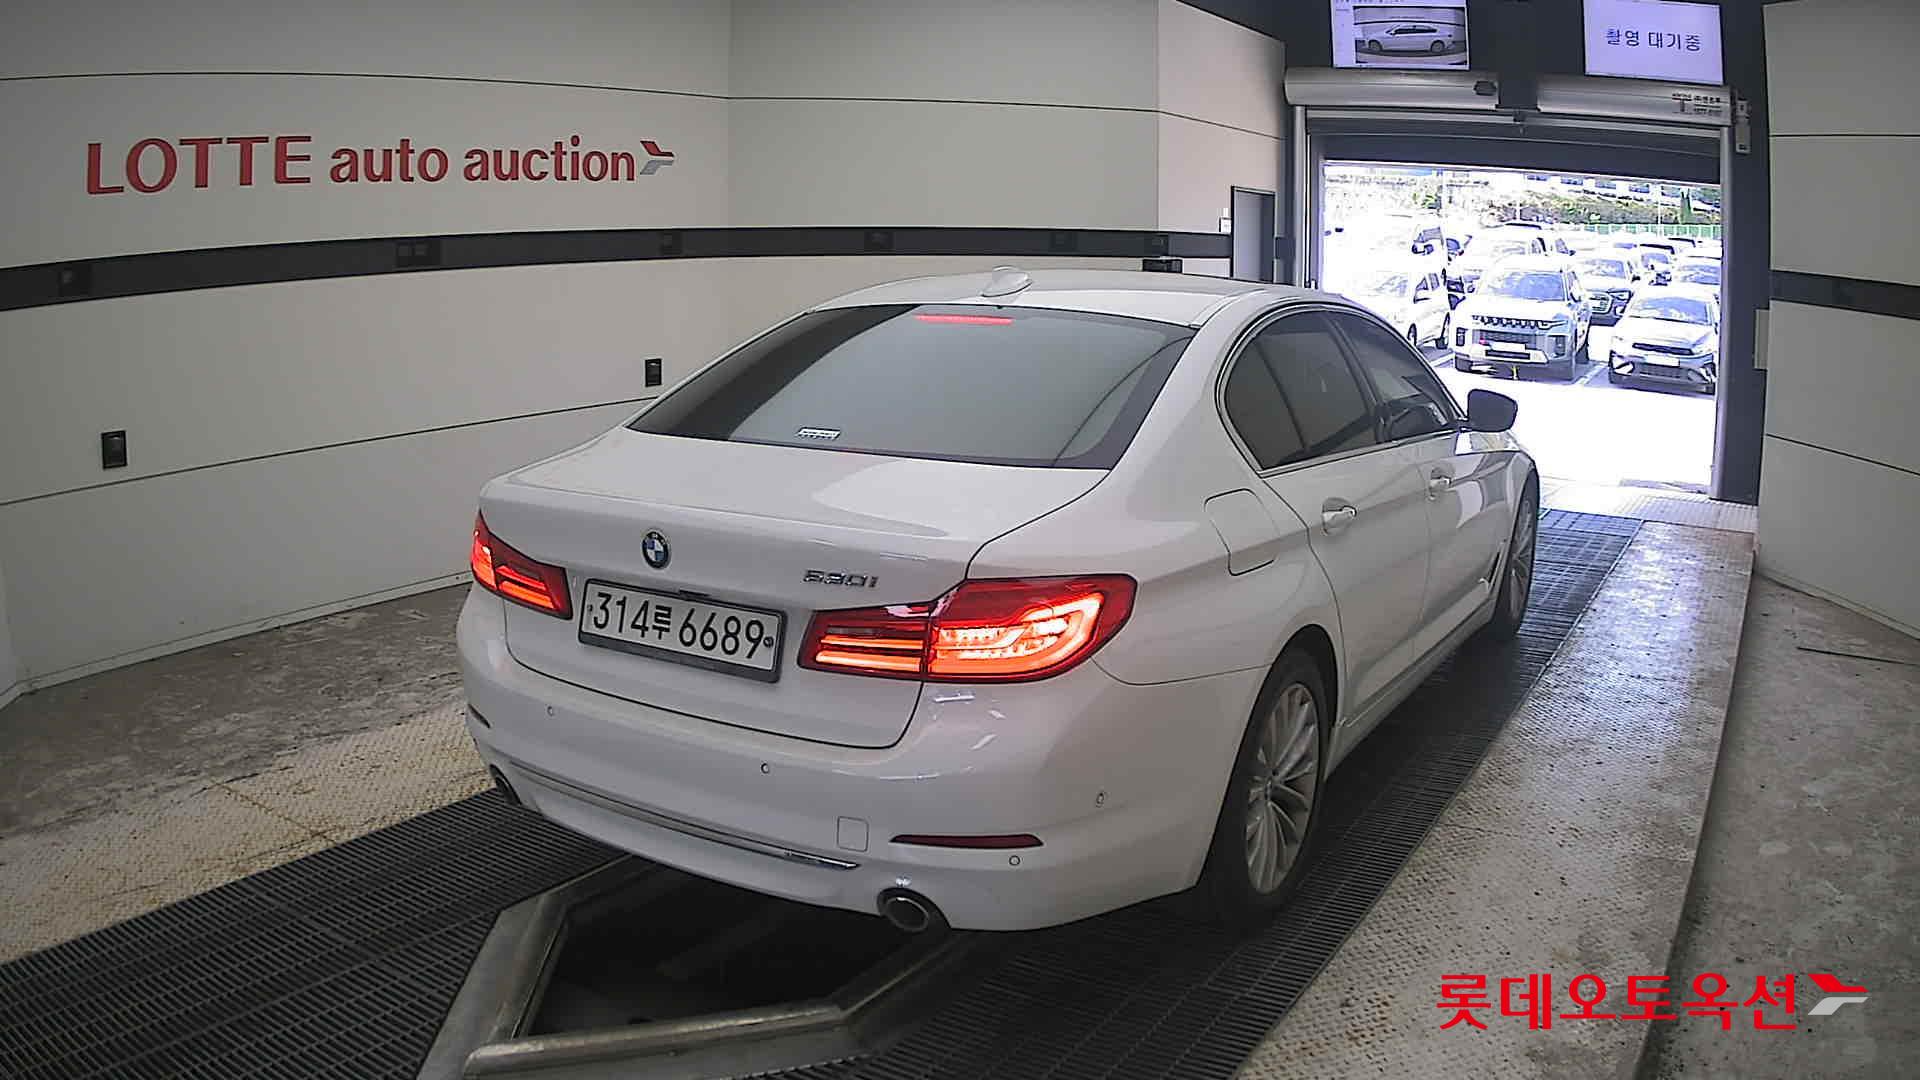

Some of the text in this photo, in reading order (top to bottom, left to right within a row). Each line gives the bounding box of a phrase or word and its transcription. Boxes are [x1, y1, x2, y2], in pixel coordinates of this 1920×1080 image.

[88, 135, 635, 194] LOTTE auto auction
